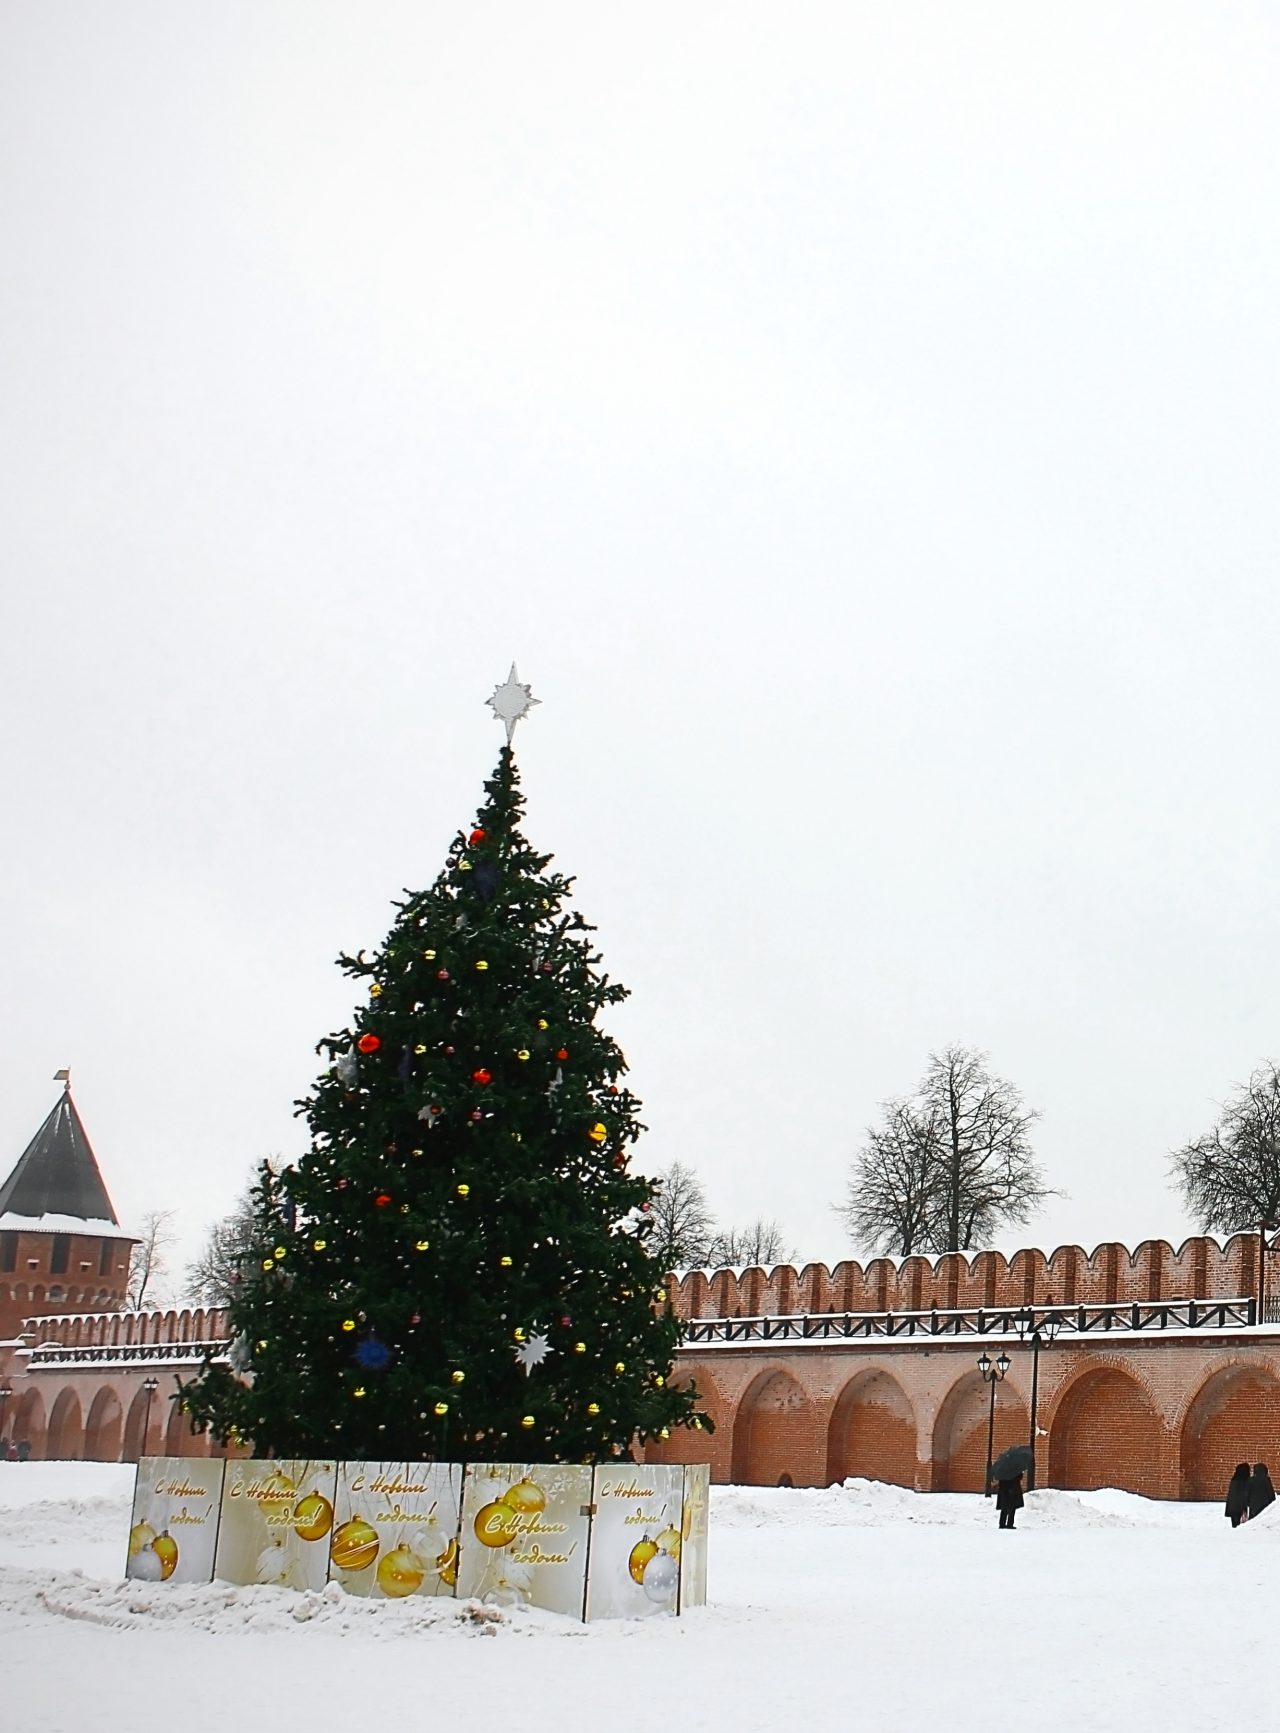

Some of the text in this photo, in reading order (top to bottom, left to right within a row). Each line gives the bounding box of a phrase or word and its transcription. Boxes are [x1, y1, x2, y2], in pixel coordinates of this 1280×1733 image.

[154, 1475, 207, 1497] С Новым
[230, 1481, 298, 1499] С Новым
[351, 1473, 428, 1494] С Новым
[601, 1479, 655, 1498] С Новым
[169, 1504, 213, 1525] годом!
[267, 1504, 323, 1526] годом!
[376, 1501, 438, 1523] годом!
[624, 1504, 667, 1525] годом!
[485, 1512, 569, 1534] С Новым
[513, 1541, 577, 1563] годом!
